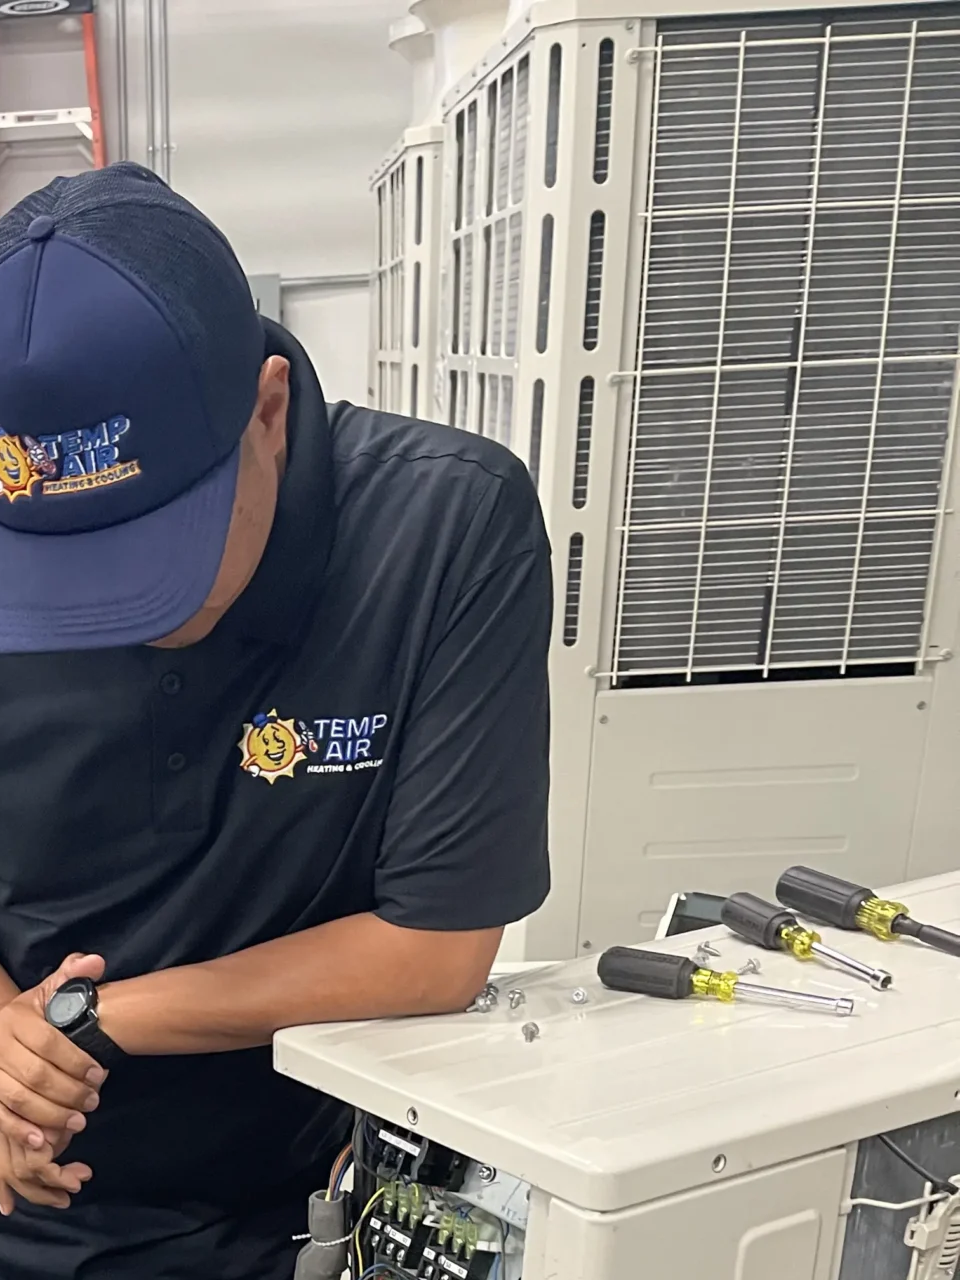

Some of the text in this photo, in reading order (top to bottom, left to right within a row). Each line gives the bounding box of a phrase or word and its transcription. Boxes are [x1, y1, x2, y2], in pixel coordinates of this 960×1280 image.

[37, 415, 130, 460] TEMP
[62, 444, 120, 477] AIR
[46, 480, 85, 491] HEATING
[95, 463, 137, 485] COOLING
[314, 714, 387, 739] TEMP
[325, 739, 371, 761] AIR
[306, 758, 384, 774] HEATING & COOLIN
